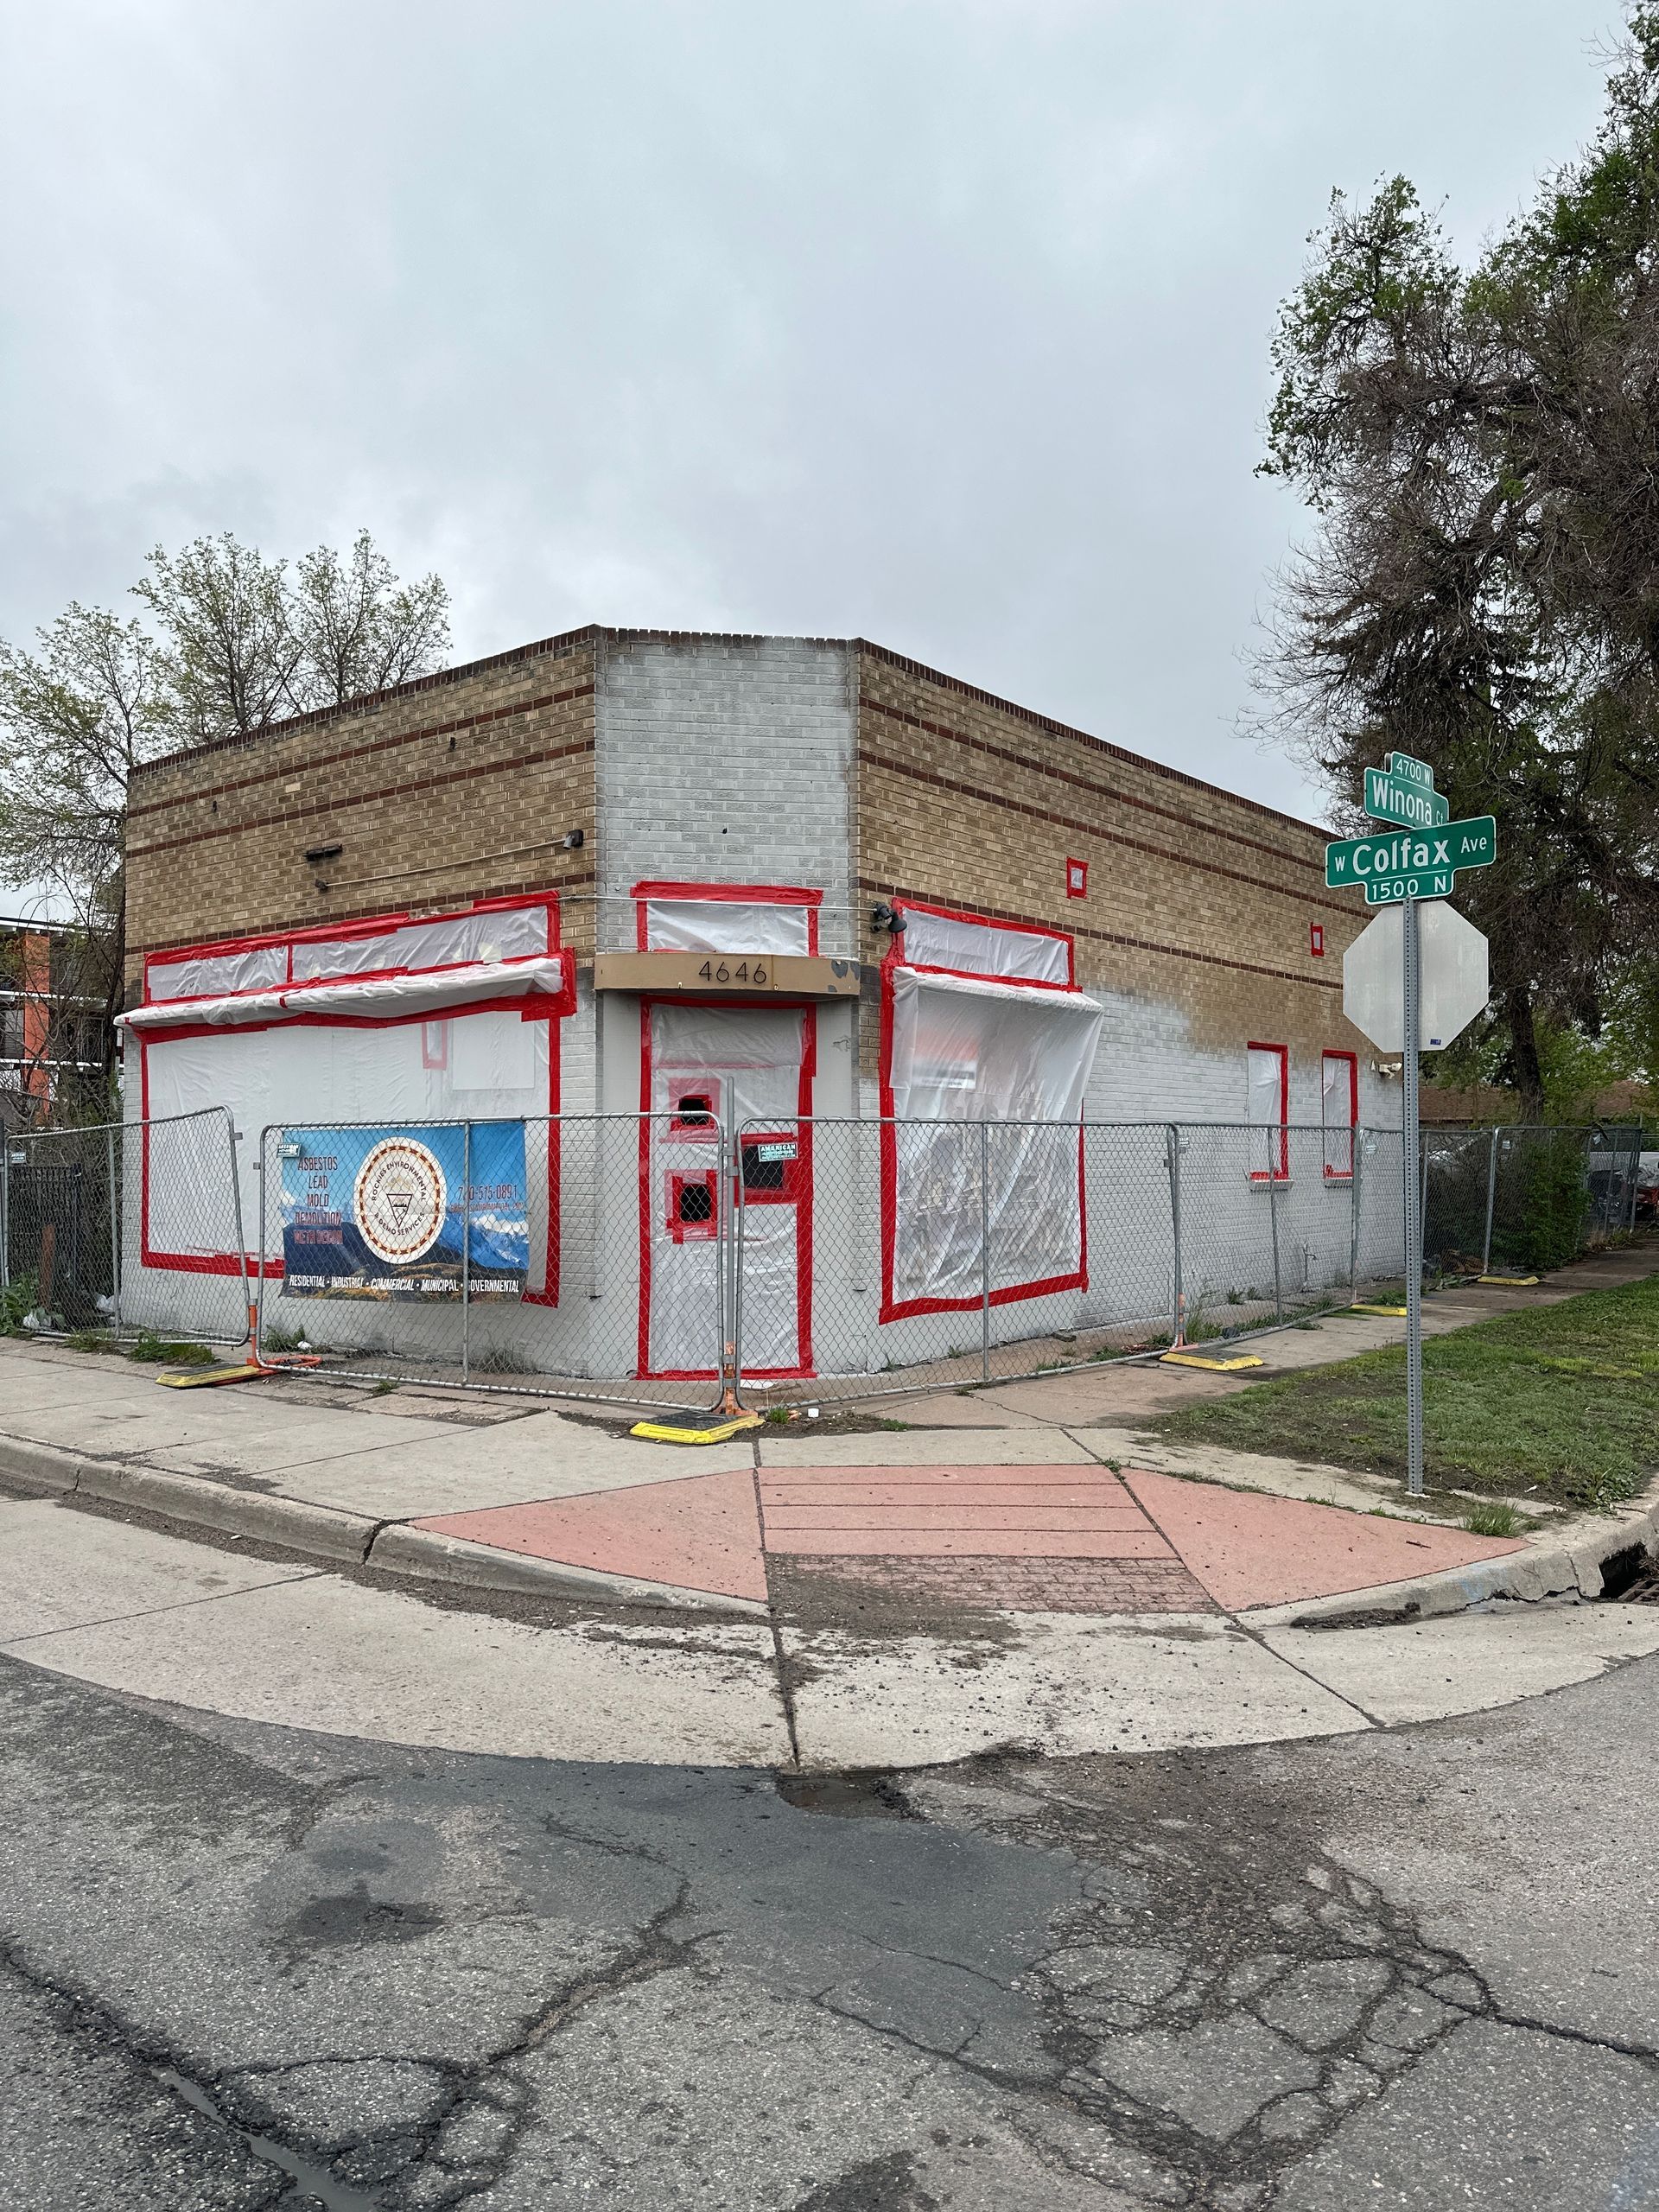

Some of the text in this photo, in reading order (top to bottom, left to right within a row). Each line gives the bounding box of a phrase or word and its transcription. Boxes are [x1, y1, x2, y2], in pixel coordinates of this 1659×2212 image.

[1396, 758, 1431, 786] 4700 W
[1372, 775, 1444, 826] Winona Ct
[1334, 836, 1487, 876] W Colfax Ave
[1372, 875, 1446, 900] 1500 N
[698, 960, 767, 984] 4646
[760, 1143, 796, 1152] AMERICAN
[297, 1156, 338, 1171] ASBESTOS
[308, 1175, 328, 1189] LEAD
[372, 1160, 427, 1202] ROCKIES ENVIRONMENTAL
[307, 1193, 329, 1207] MOLD
[458, 1184, 517, 1201] 70-515-0891
[295, 1211, 342, 1225] DEMOLITION
[378, 1218, 397, 1235] DEMO
[397, 1211, 425, 1236] SERVICES
[289, 1274, 519, 1293] RESIDENTIAL INDUSTRIAL COMMERCIAL MUNICIPAL OVERNMENTAL
